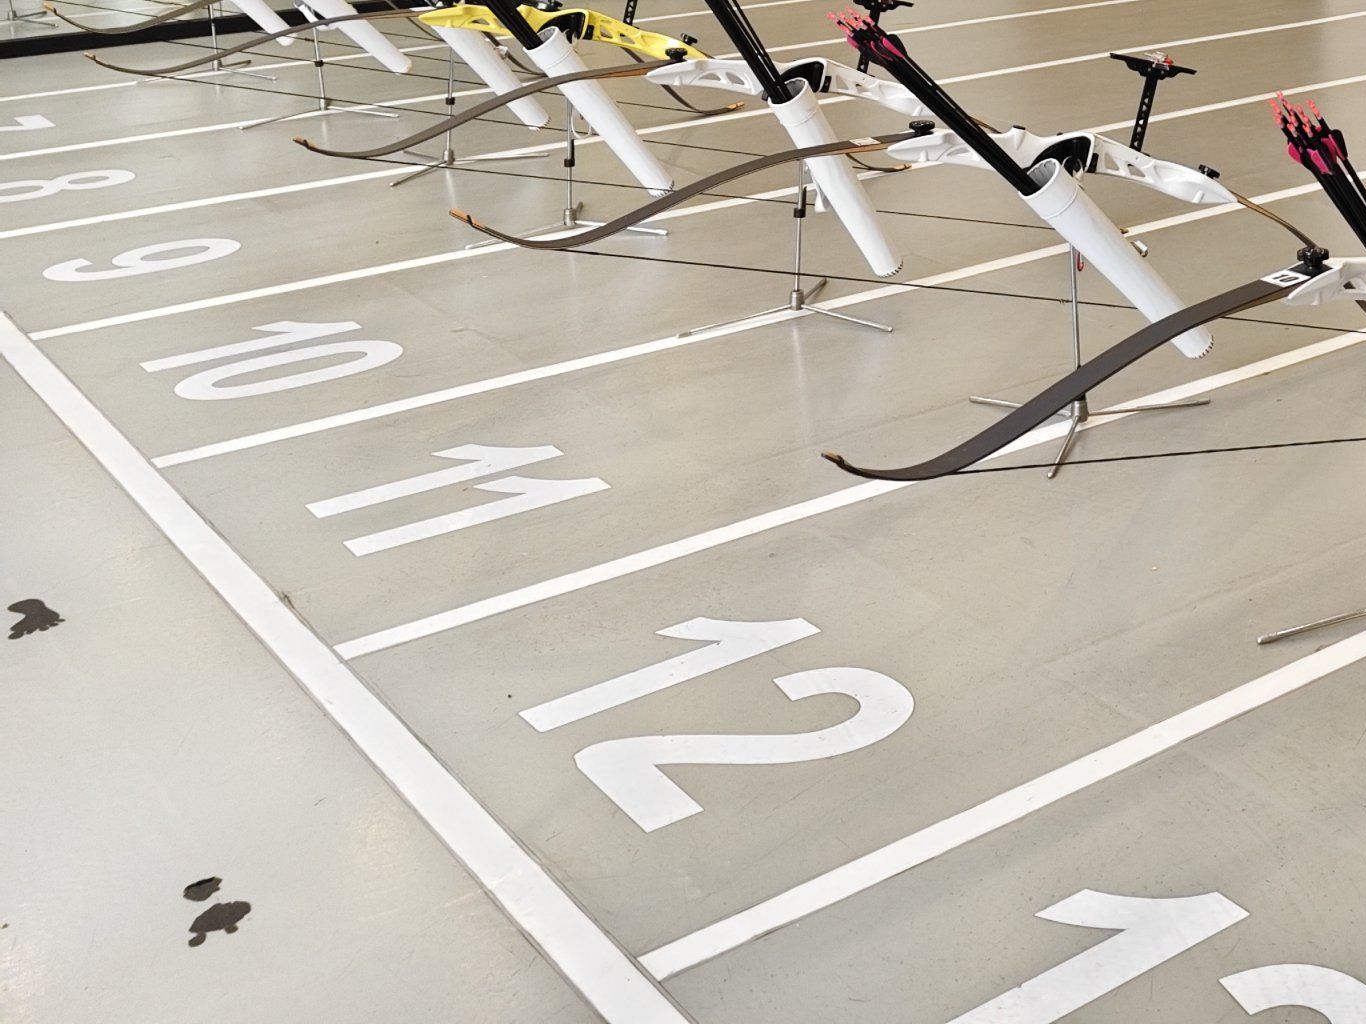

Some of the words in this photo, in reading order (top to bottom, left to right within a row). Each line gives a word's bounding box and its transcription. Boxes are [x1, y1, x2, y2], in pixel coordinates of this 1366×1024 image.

[0, 169, 136, 203] 8
[42, 237, 241, 282] 9
[1272, 274, 1300, 283] 10
[138, 320, 404, 401] 10
[304, 443, 612, 559] 11
[518, 616, 915, 834] 12
